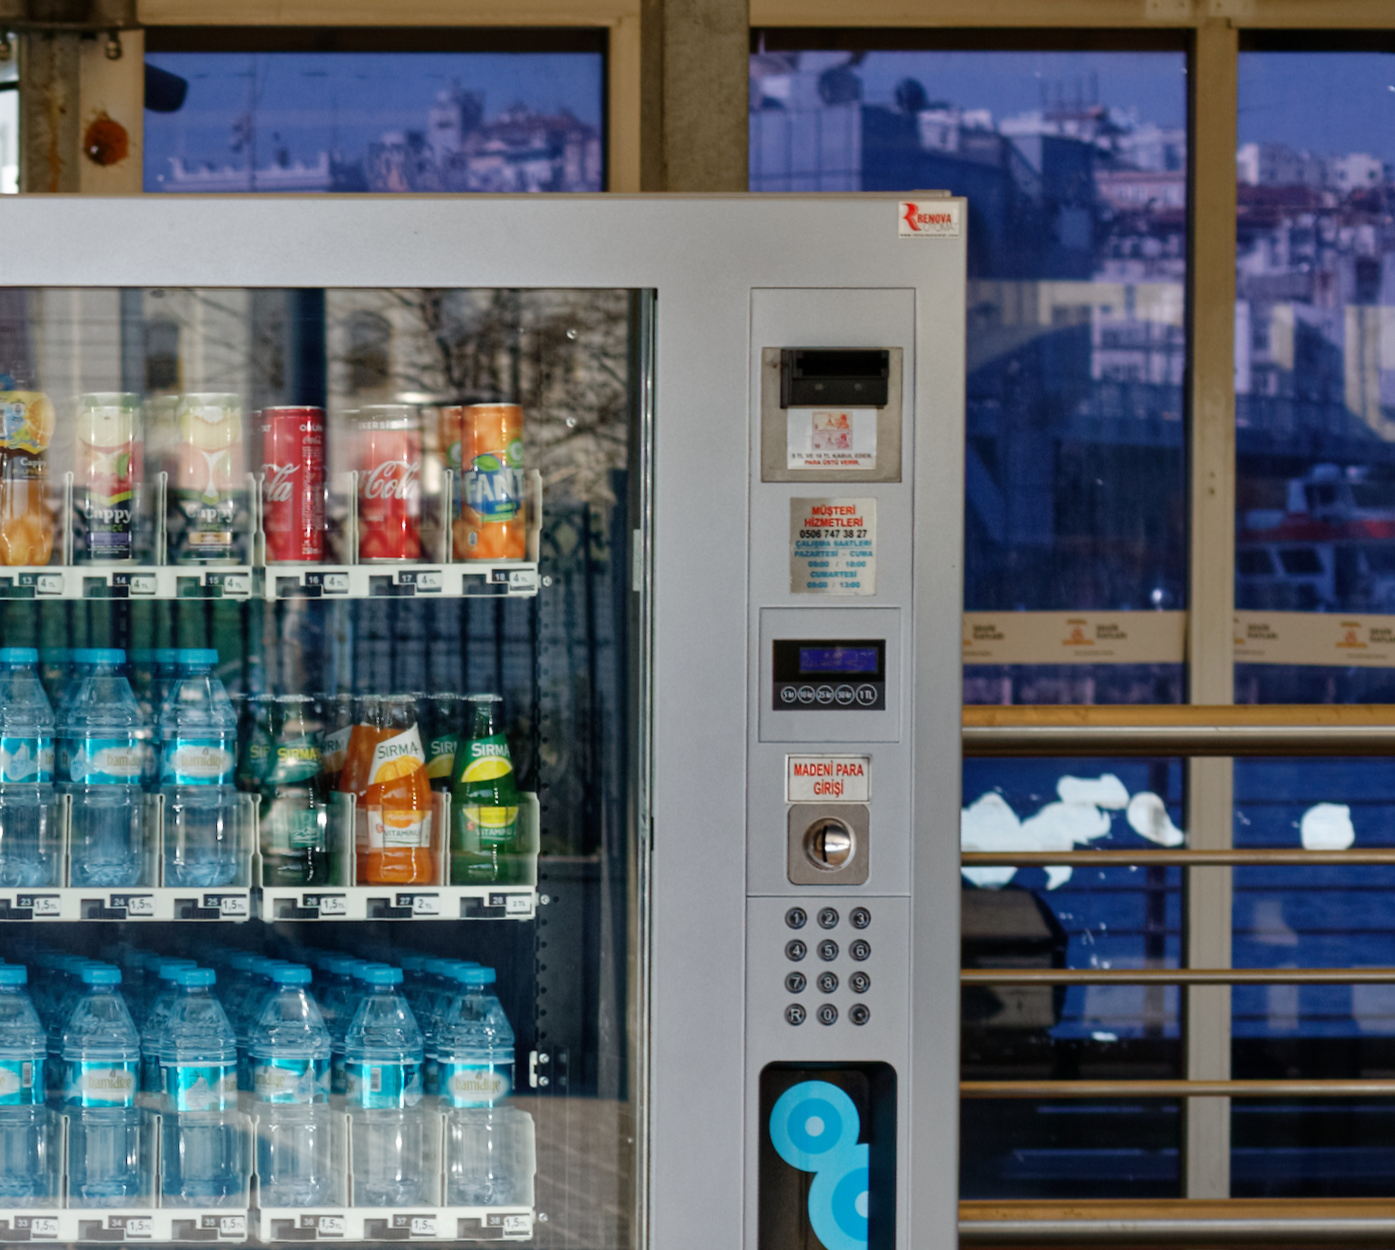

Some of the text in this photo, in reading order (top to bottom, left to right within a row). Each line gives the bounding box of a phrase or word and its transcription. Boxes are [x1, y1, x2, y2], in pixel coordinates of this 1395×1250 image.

[917, 213, 951, 223] RENOVA
[84, 502, 132, 524] Cappy
[812, 505, 855, 516] MÜŞTERİ
[805, 517, 863, 527] HİZMETLERİ
[800, 529, 867, 538] 0506 747 38 27
[378, 742, 418, 760] SIRMA
[794, 760, 864, 776] MADENİ PARA
[814, 778, 844, 797] GİRİŞİ
